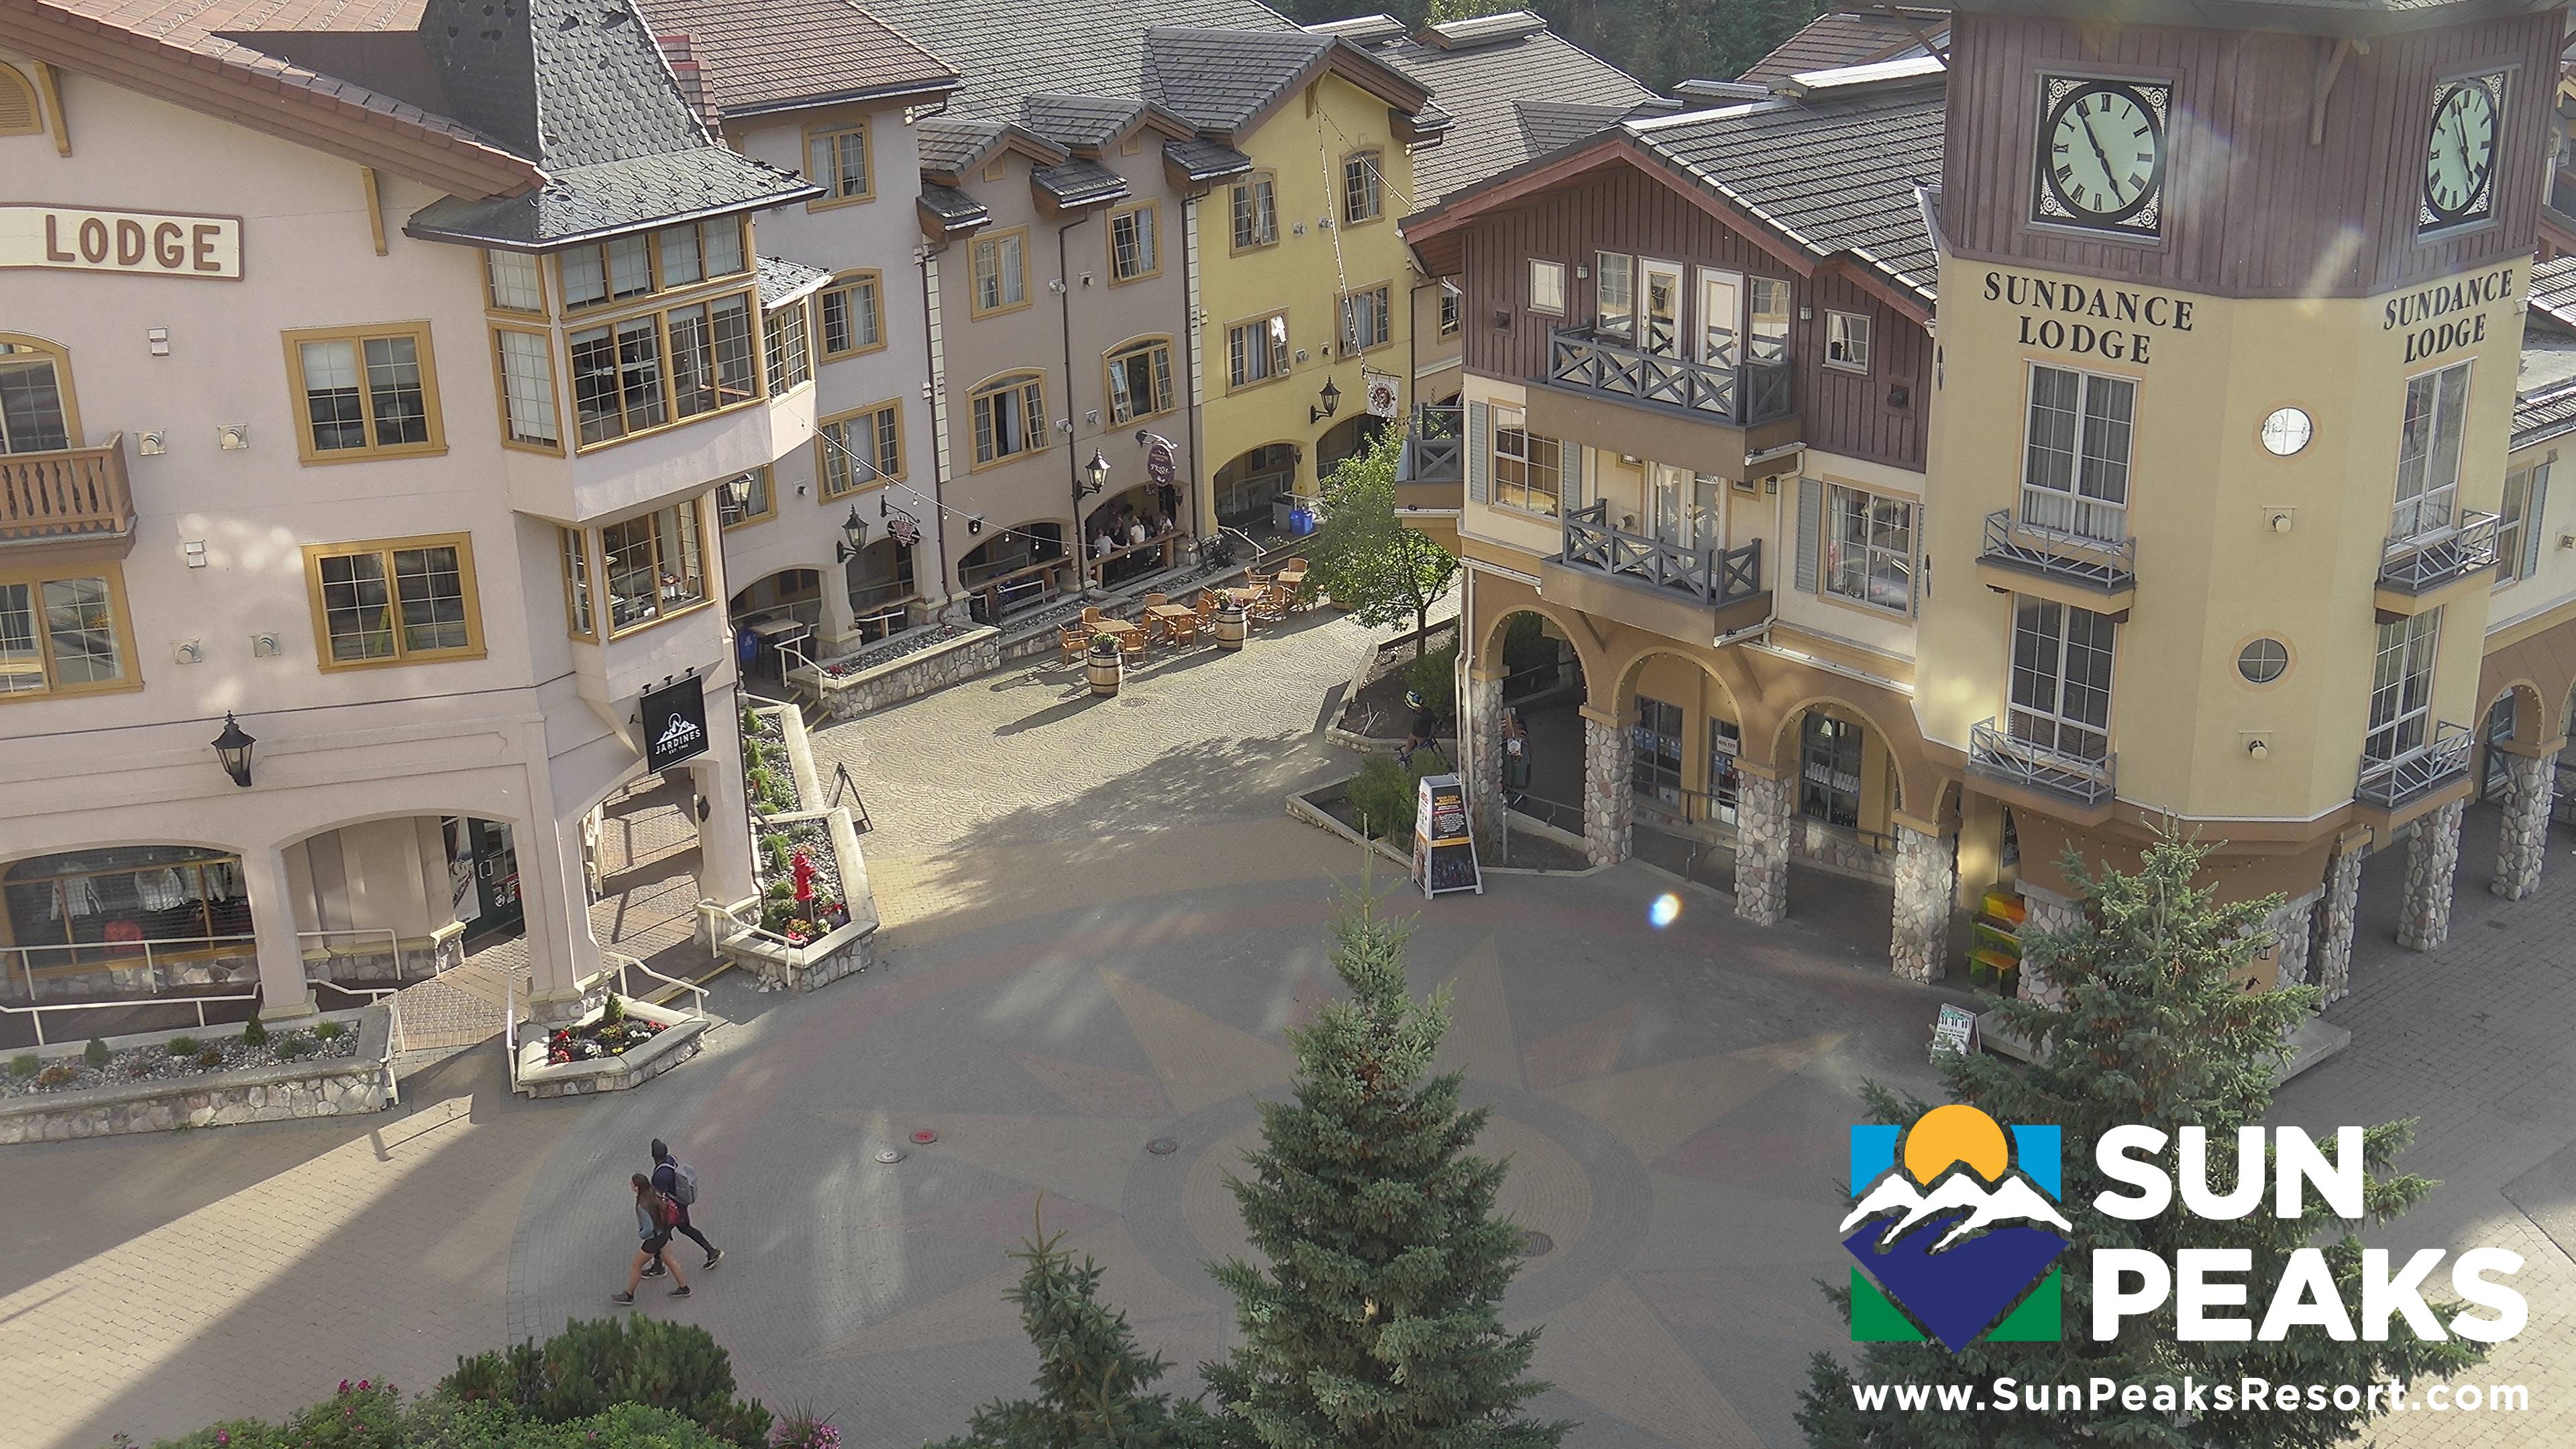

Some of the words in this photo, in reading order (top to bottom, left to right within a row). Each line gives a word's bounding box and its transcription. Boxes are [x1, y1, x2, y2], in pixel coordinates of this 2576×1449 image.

[46, 214, 221, 272] LODGE
[1984, 272, 2193, 331] SUNDANCE
[2383, 269, 2513, 330] SUNDANCE
[2019, 315, 2150, 364] LODGE
[2404, 313, 2487, 364] LODGE
[655, 729, 701, 755] JARDINES
